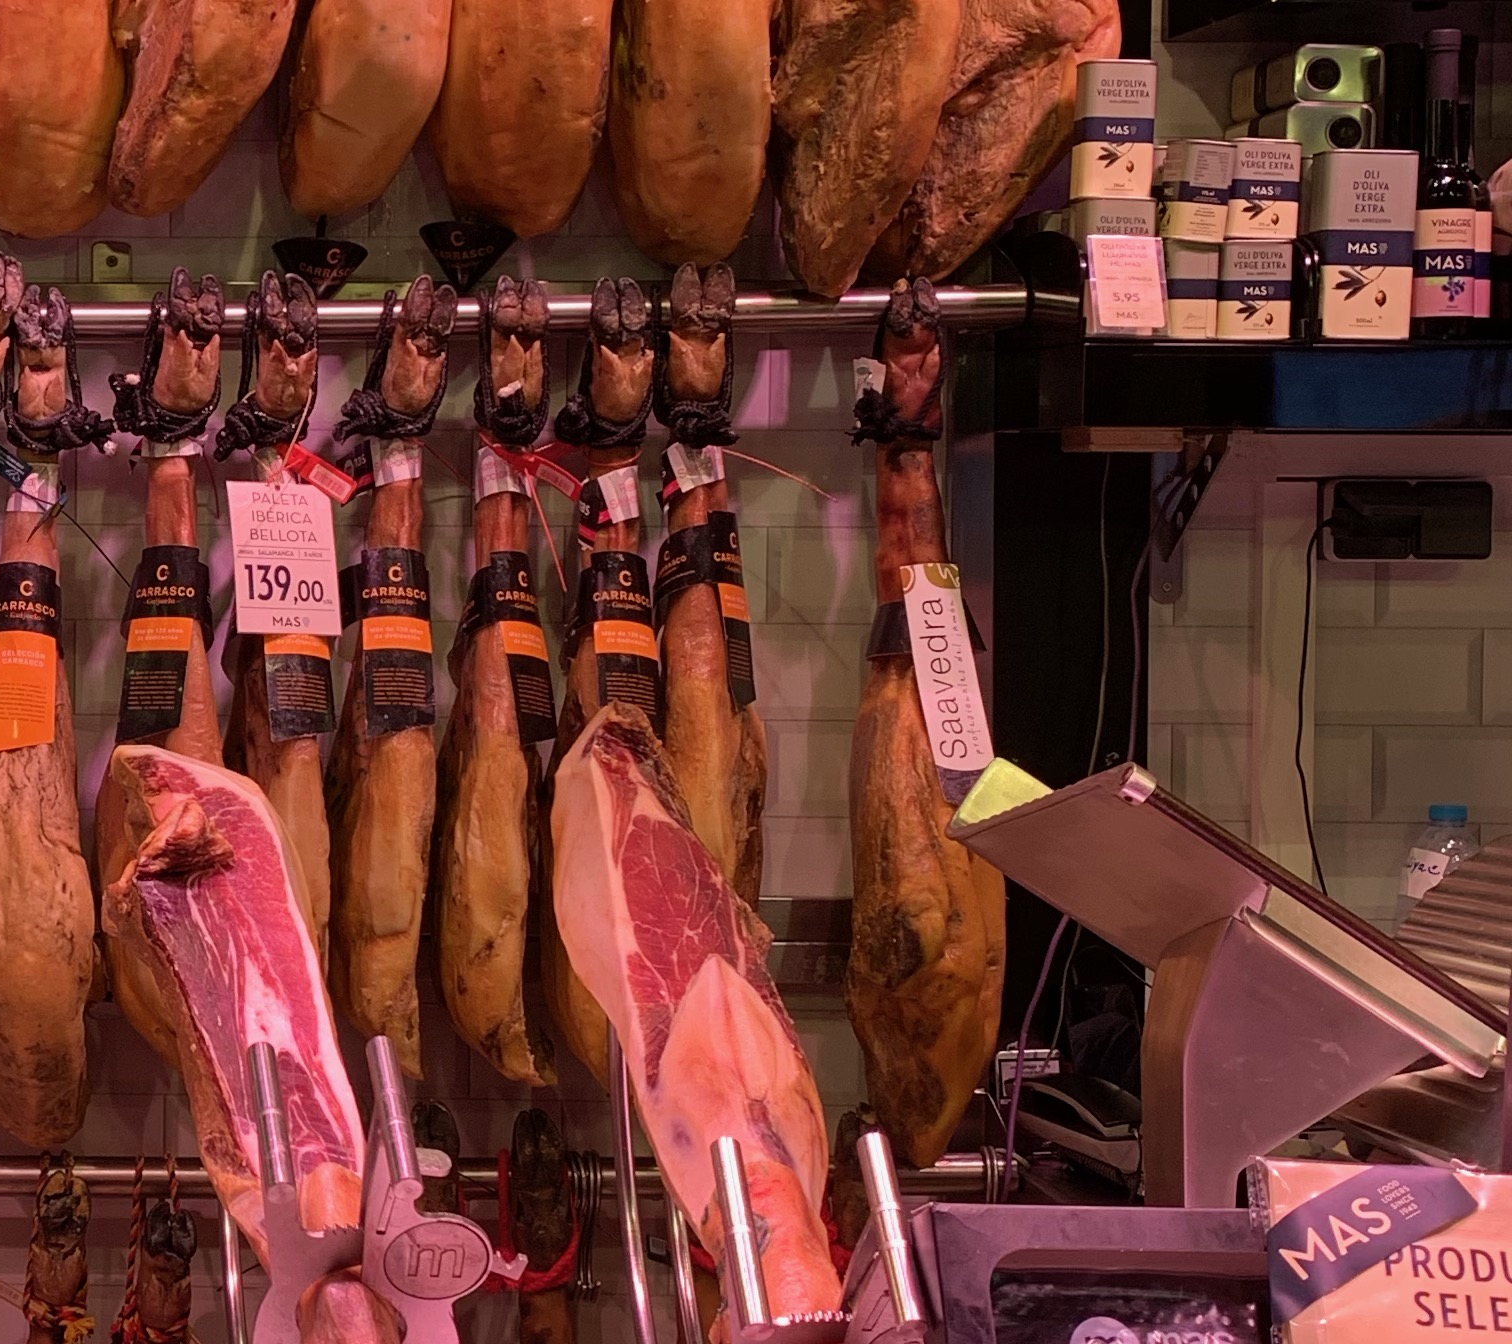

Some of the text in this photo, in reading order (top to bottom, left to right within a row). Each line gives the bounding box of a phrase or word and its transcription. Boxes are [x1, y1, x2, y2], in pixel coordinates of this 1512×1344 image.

[1100, 78, 1114, 88] OLI
[1097, 88, 1151, 99] VERGE EXTRA
[1105, 124, 1130, 136] MAS
[1363, 169, 1380, 180] OLI
[1355, 192, 1386, 203] VERGE
[1354, 203, 1386, 214] EXTRA
[1431, 218, 1472, 228] VINAGRE
[1347, 241, 1378, 255] MAS
[1424, 254, 1465, 271] MAS
[251, 491, 309, 508] PALETA
[250, 507, 313, 526] IBÉRICA
[249, 528, 318, 545] BELLOTA
[244, 564, 323, 604] 139,00
[135, 585, 196, 600] CARRASCO
[272, 615, 302, 628] MAS
[919, 597, 967, 759] Saavedra
[1278, 1197, 1392, 1280] MAS
